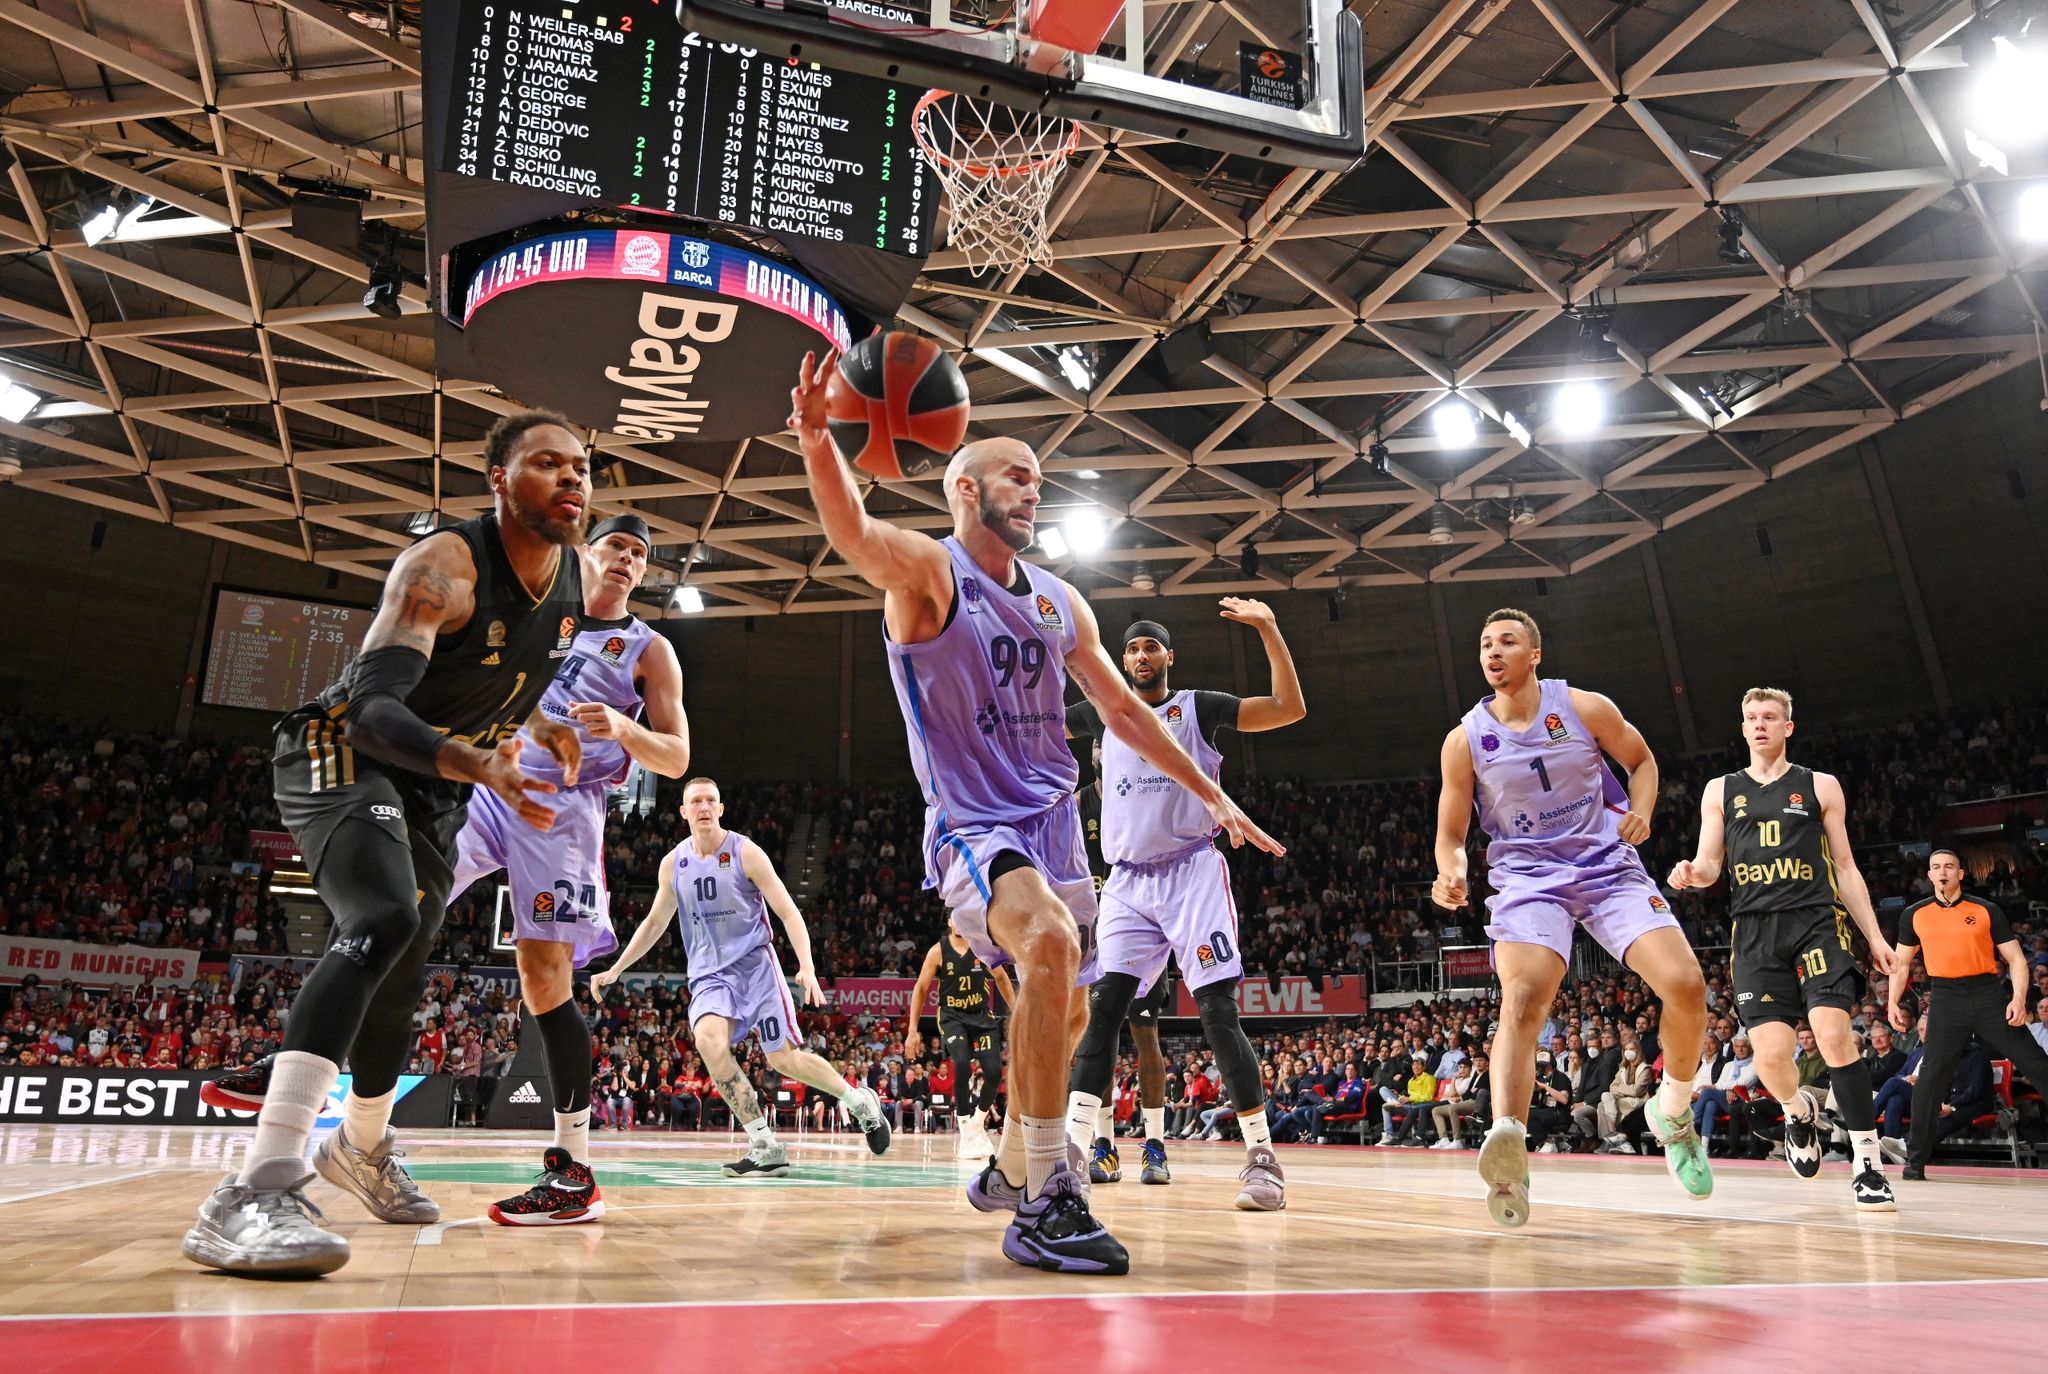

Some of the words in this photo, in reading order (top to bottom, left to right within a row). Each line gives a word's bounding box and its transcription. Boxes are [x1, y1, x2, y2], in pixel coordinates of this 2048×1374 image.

[484, 6, 494, 18] 0
[510, 10, 524, 25] N.
[529, 14, 624, 44] WEILER-BAB
[646, 39, 655, 51] 2
[681, 46, 690, 58] 9
[620, 15, 633, 32] 2
[836, 0, 914, 24] BARCELONA
[481, 34, 491, 47] 8
[506, 39, 522, 53] O.
[527, 43, 592, 67] HUNTER
[643, 67, 652, 79] 2
[679, 73, 688, 85] 7
[484, 21, 491, 32] 1
[508, 25, 523, 39] D.
[528, 28, 594, 53] THOMAS
[645, 53, 652, 64] 1
[679, 60, 689, 72] 4
[470, 62, 486, 75] 11
[503, 67, 517, 81] V.
[522, 71, 569, 91] LUCIC
[640, 94, 650, 107] 2
[668, 99, 685, 113] 17
[472, 47, 489, 61] 10
[505, 53, 520, 67] O.
[525, 58, 598, 82] JARAMAZ
[642, 80, 651, 92] 3
[677, 87, 686, 99] 8
[740, 58, 749, 70] 0
[763, 62, 776, 76] B.
[780, 66, 832, 87] DAVIES
[888, 89, 896, 101] 2
[740, 72, 746, 84] 1
[762, 76, 776, 90] D.
[780, 80, 821, 99] EXUM
[886, 103, 895, 114] 4
[1250, 75, 1294, 93] TURKISH
[1250, 84, 1295, 101] AIRLINES
[467, 90, 484, 104] 13
[499, 96, 514, 110] A.
[519, 100, 563, 118] OBST
[673, 129, 682, 141] 0
[469, 76, 486, 90] 12
[501, 82, 513, 95] J.
[518, 85, 587, 109] GEORGE
[674, 115, 684, 127] 0
[736, 99, 745, 111] 8
[759, 103, 772, 117] S.
[777, 107, 849, 132] MARTINEZ
[738, 85, 747, 97] 5
[760, 90, 773, 103] S.
[778, 93, 819, 112] SANLI
[885, 115, 894, 127] 3
[462, 119, 479, 133] 21
[496, 125, 510, 139] A.
[516, 128, 564, 147] RUBIT
[635, 151, 642, 162] 1
[662, 155, 680, 169] 14
[465, 105, 482, 118] 14
[499, 110, 513, 124] N.
[518, 114, 589, 138] DEDOVIC
[636, 136, 645, 148] 2
[671, 143, 681, 155] 0
[727, 126, 743, 139] 14
[757, 131, 771, 144] N.
[775, 134, 823, 154] HAYES
[882, 156, 891, 167] 2
[914, 162, 923, 174] 2
[728, 112, 744, 125] 10
[758, 117, 772, 131] R.
[776, 121, 820, 140] SMITS
[884, 142, 890, 154] 1
[908, 147, 923, 160] 12
[459, 148, 477, 162] 34
[493, 154, 509, 167] G.
[514, 157, 596, 183] SCHILLING
[667, 185, 677, 197] 0
[461, 133, 478, 147] 31
[494, 139, 508, 153] Z.
[513, 142, 561, 162] SISKO
[633, 165, 643, 177] 2
[669, 171, 678, 183] 0
[723, 153, 739, 166] 21
[754, 158, 768, 171] A.
[771, 162, 834, 184] ABRINES
[912, 188, 921, 200] 0
[724, 139, 742, 152] 20
[756, 144, 770, 158] N.
[774, 148, 863, 175] LAPROVITTO
[881, 169, 890, 181] 2
[914, 175, 922, 187] 9
[457, 163, 476, 176] 43
[492, 168, 504, 182] L.
[510, 171, 601, 198] RADOSEVIC
[630, 193, 640, 205] 2
[666, 199, 676, 212] 2
[721, 180, 736, 194] 31
[752, 186, 766, 199] R.
[770, 190, 853, 215] JOKUBAITIS
[878, 209, 887, 221] 2
[910, 215, 919, 227] 0
[722, 167, 739, 180] 24
[753, 172, 766, 186] K.
[771, 175, 815, 194] KURIC
[880, 196, 886, 207] 1
[912, 202, 920, 213] 7
[719, 208, 736, 222] 99
[750, 213, 764, 227] N.
[768, 217, 844, 241] CALATHES
[876, 236, 885, 248] 3
[908, 242, 917, 254] 8
[720, 194, 736, 208] 33
[751, 199, 765, 213] N.
[769, 203, 829, 224] MIROTIC
[877, 223, 886, 235] 4
[902, 227, 918, 241] 25
[497, 243, 545, 288] 20:45
[548, 237, 588, 273] UHR
[673, 269, 713, 287] BARÇA
[746, 259, 810, 318] BAYERN
[604, 291, 739, 441] BayWa
[309, 618, 319, 627] 4.
[320, 622, 343, 630] Quarter
[309, 628, 344, 644] 2:35
[553, 654, 588, 690] 4
[990, 634, 1047, 690] 99
[1529, 756, 1552, 793] 1
[1538, 794, 1594, 821] Assistència
[1540, 810, 1583, 832] Sanitària
[1757, 820, 1781, 847] 10
[693, 876, 718, 902] 10
[1734, 857, 1814, 886] BayWa
[554, 879, 599, 923] 24
[8, 946, 61, 970] RED
[1209, 930, 1234, 963] 0
[1801, 947, 1828, 978] 10
[839, 989, 913, 1006] MAGENT
[958, 975, 972, 991] 21
[758, 1016, 781, 1043] 10
[979, 1035, 992, 1051] 21
[57, 1078, 190, 1118] BEST
[509, 1095, 542, 1104] adidas
